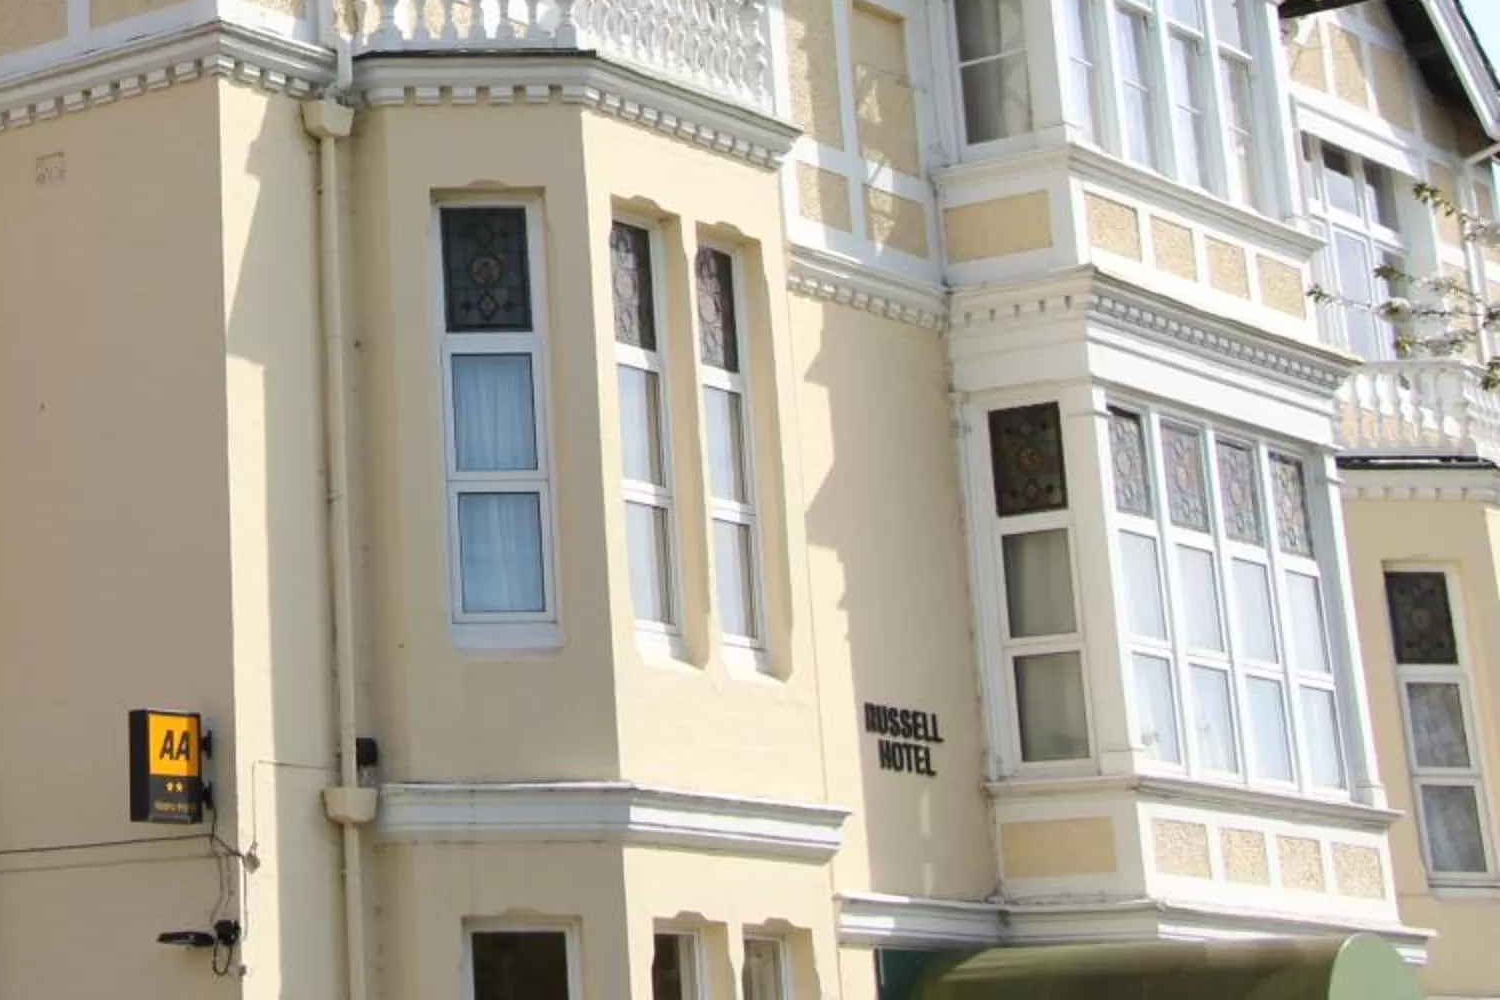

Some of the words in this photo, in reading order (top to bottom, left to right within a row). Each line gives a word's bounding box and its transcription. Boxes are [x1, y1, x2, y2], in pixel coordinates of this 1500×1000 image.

[864, 702, 944, 743] RUSSELL
[159, 729, 190, 761] AA
[878, 739, 937, 776] HOTEL
